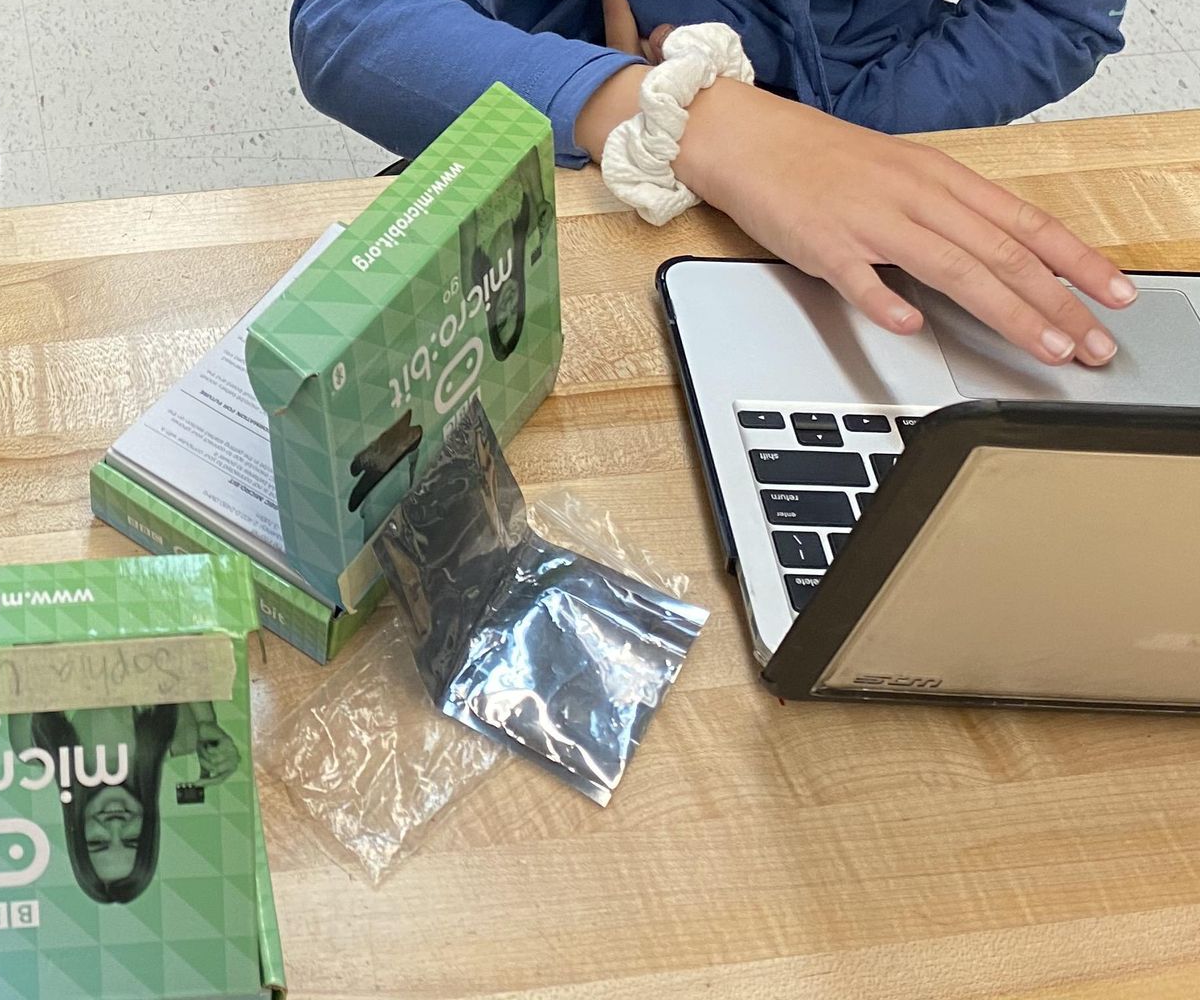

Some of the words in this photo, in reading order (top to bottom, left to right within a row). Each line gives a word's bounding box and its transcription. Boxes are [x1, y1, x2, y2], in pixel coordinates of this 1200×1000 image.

[351, 161, 465, 273] www.microbit.org
[388, 247, 512, 408] micro:bit
[759, 452, 779, 461] shift
[770, 493, 799, 501] return
[795, 577, 821, 587] elete
[53, 647, 182, 695] Sophia
